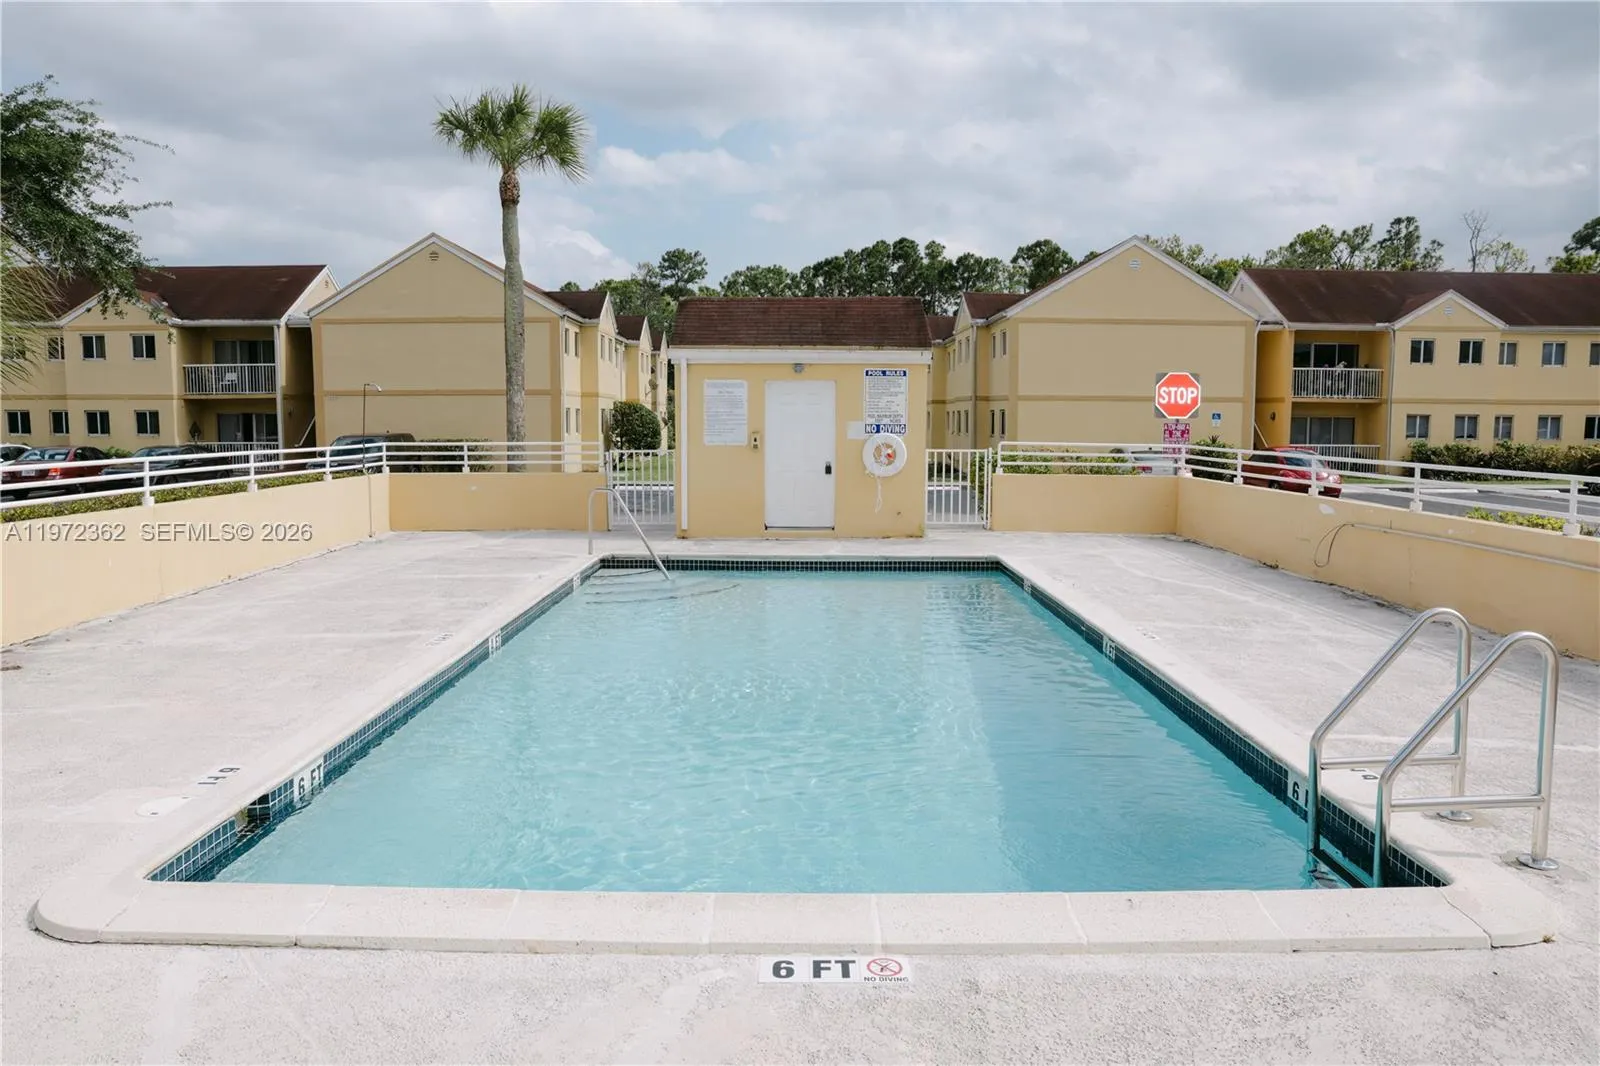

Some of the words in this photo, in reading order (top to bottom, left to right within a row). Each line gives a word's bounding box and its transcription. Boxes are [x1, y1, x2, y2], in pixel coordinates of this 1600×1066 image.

[1159, 387, 1198, 404] STOP
[866, 424, 877, 433] NO
[880, 424, 905, 433] DIVING
[298, 776, 305, 795] 6
[310, 763, 323, 786] FT
[1292, 781, 1300, 801] 6
[772, 960, 795, 979] 6
[812, 960, 856, 979] FT
